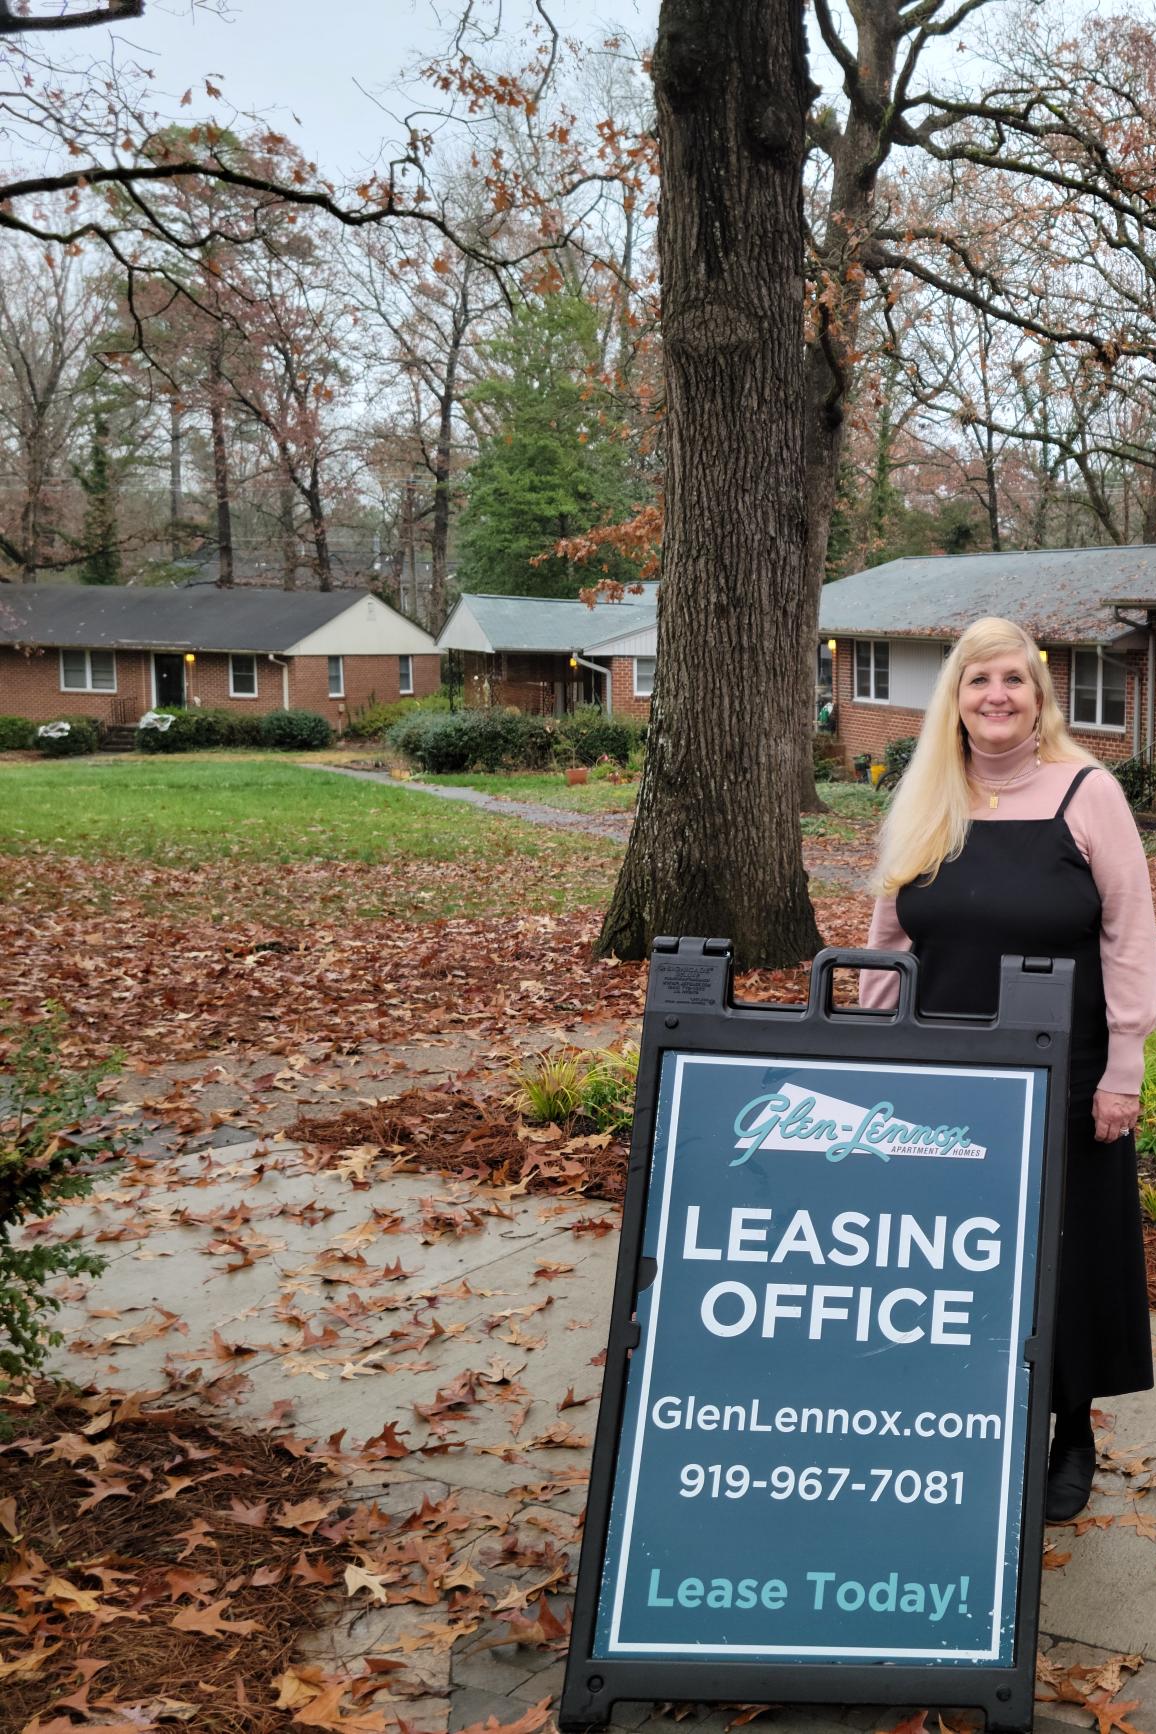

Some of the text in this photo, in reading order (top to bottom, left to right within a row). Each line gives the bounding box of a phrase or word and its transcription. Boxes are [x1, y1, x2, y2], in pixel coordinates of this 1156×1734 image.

[891, 1145, 981, 1157] APARTMENT HOMES
[683, 1205, 1001, 1272] LEASING
[701, 1280, 974, 1345] OFFICE
[652, 1396, 1002, 1440] GlenLennox.com
[679, 1464, 964, 1504] 919-967-7081
[647, 1568, 970, 1621] Lease Today!
